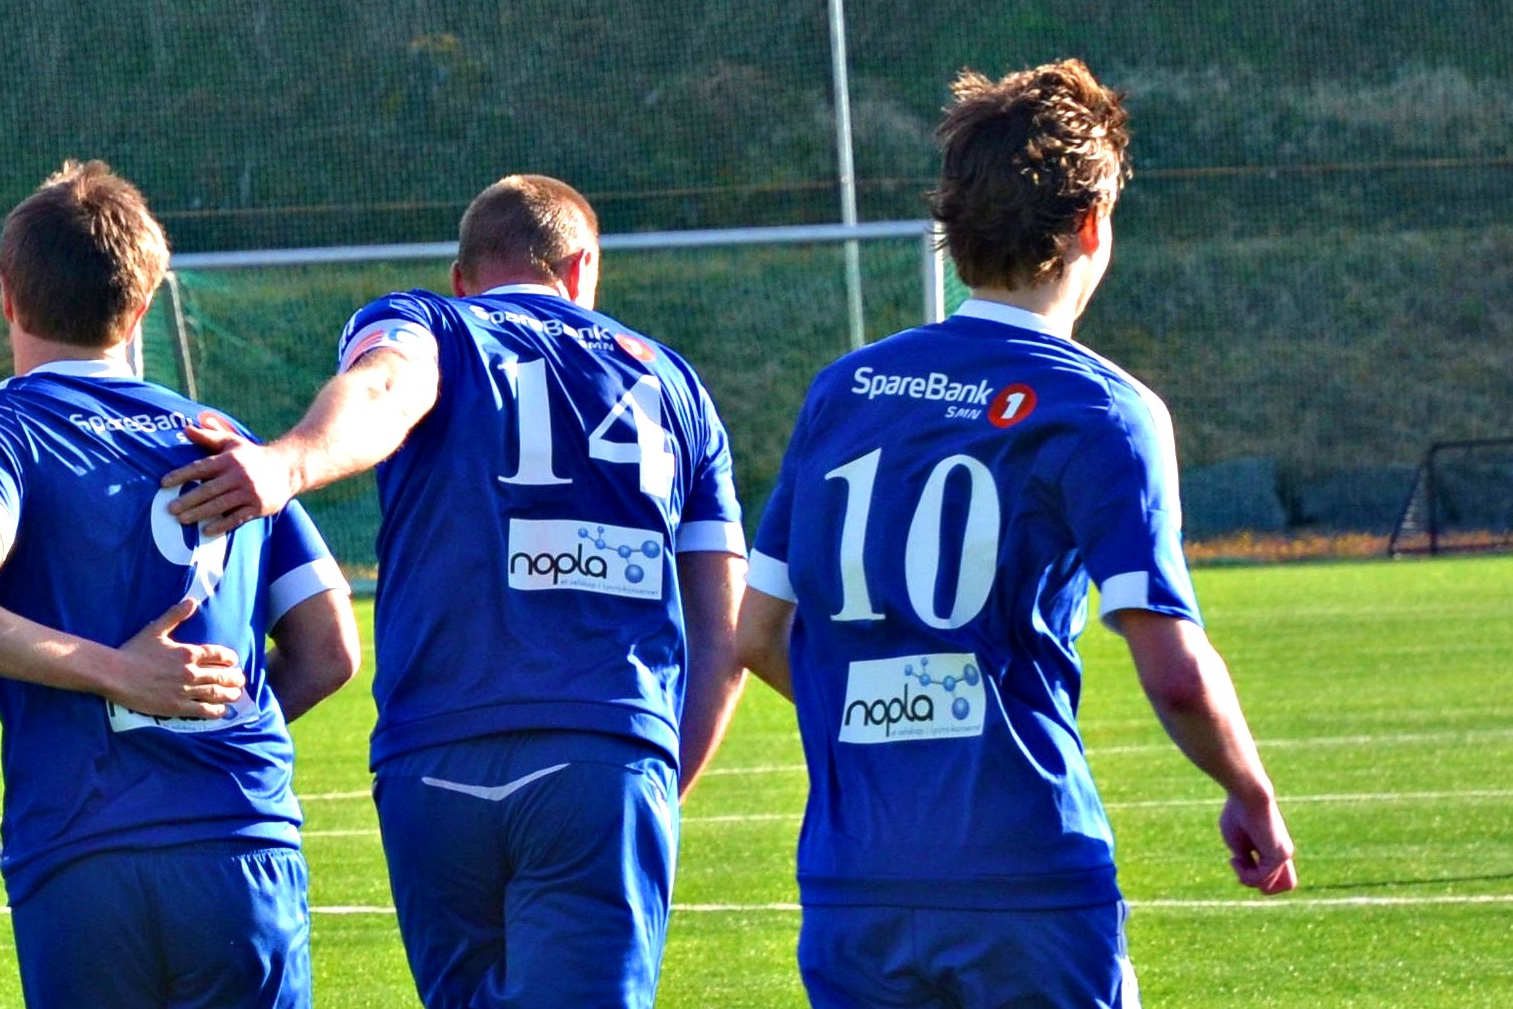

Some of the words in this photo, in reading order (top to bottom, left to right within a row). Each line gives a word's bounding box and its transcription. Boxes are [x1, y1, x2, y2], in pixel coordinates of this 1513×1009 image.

[851, 366, 994, 405] SpareBank
[1000, 392, 1026, 420] 1
[944, 405, 982, 420] SMN
[69, 411, 192, 435] SpareBan
[498, 358, 674, 500] 14
[509, 543, 608, 585] nopla
[824, 447, 1001, 630] 10
[844, 683, 934, 737] nopla
